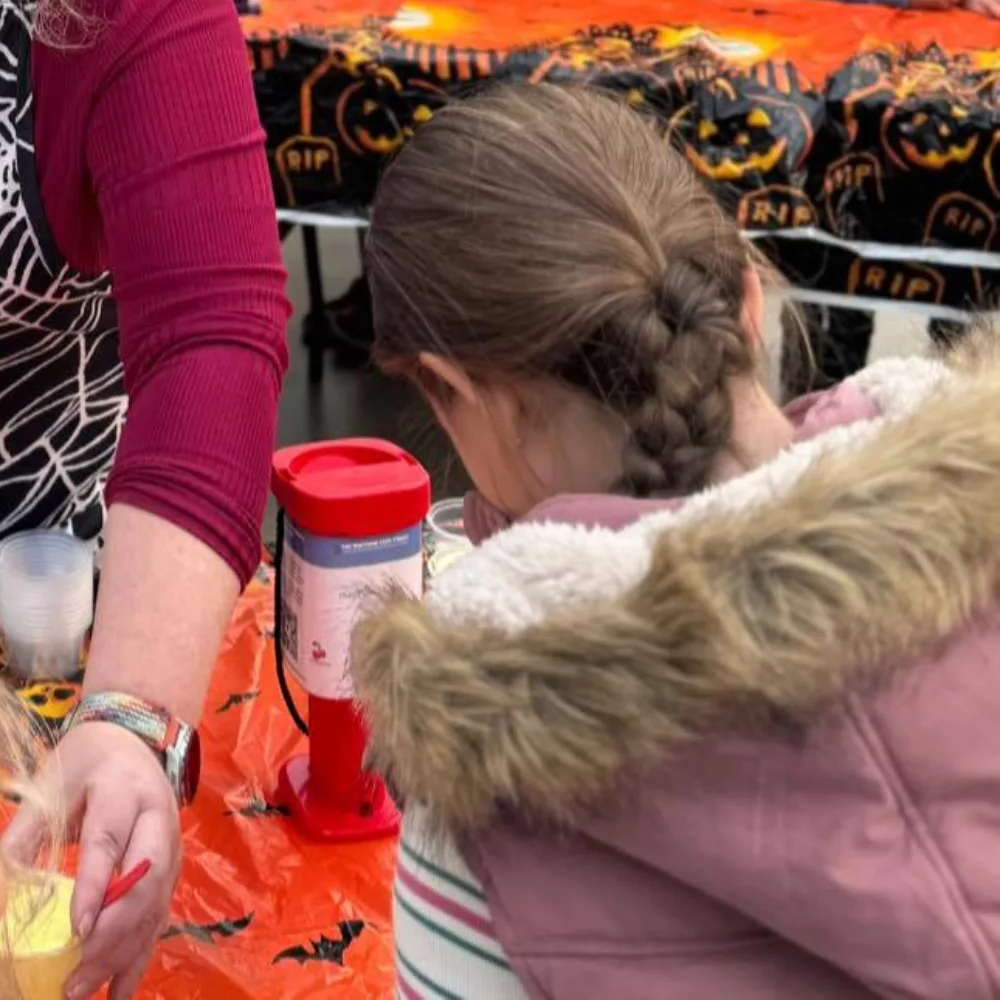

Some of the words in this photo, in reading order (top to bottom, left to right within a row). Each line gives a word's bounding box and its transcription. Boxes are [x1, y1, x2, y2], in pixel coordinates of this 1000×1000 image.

[287, 149, 330, 171] RIP
[752, 200, 812, 227] RIP
[945, 206, 986, 236] RIP
[864, 264, 931, 299] RIP
